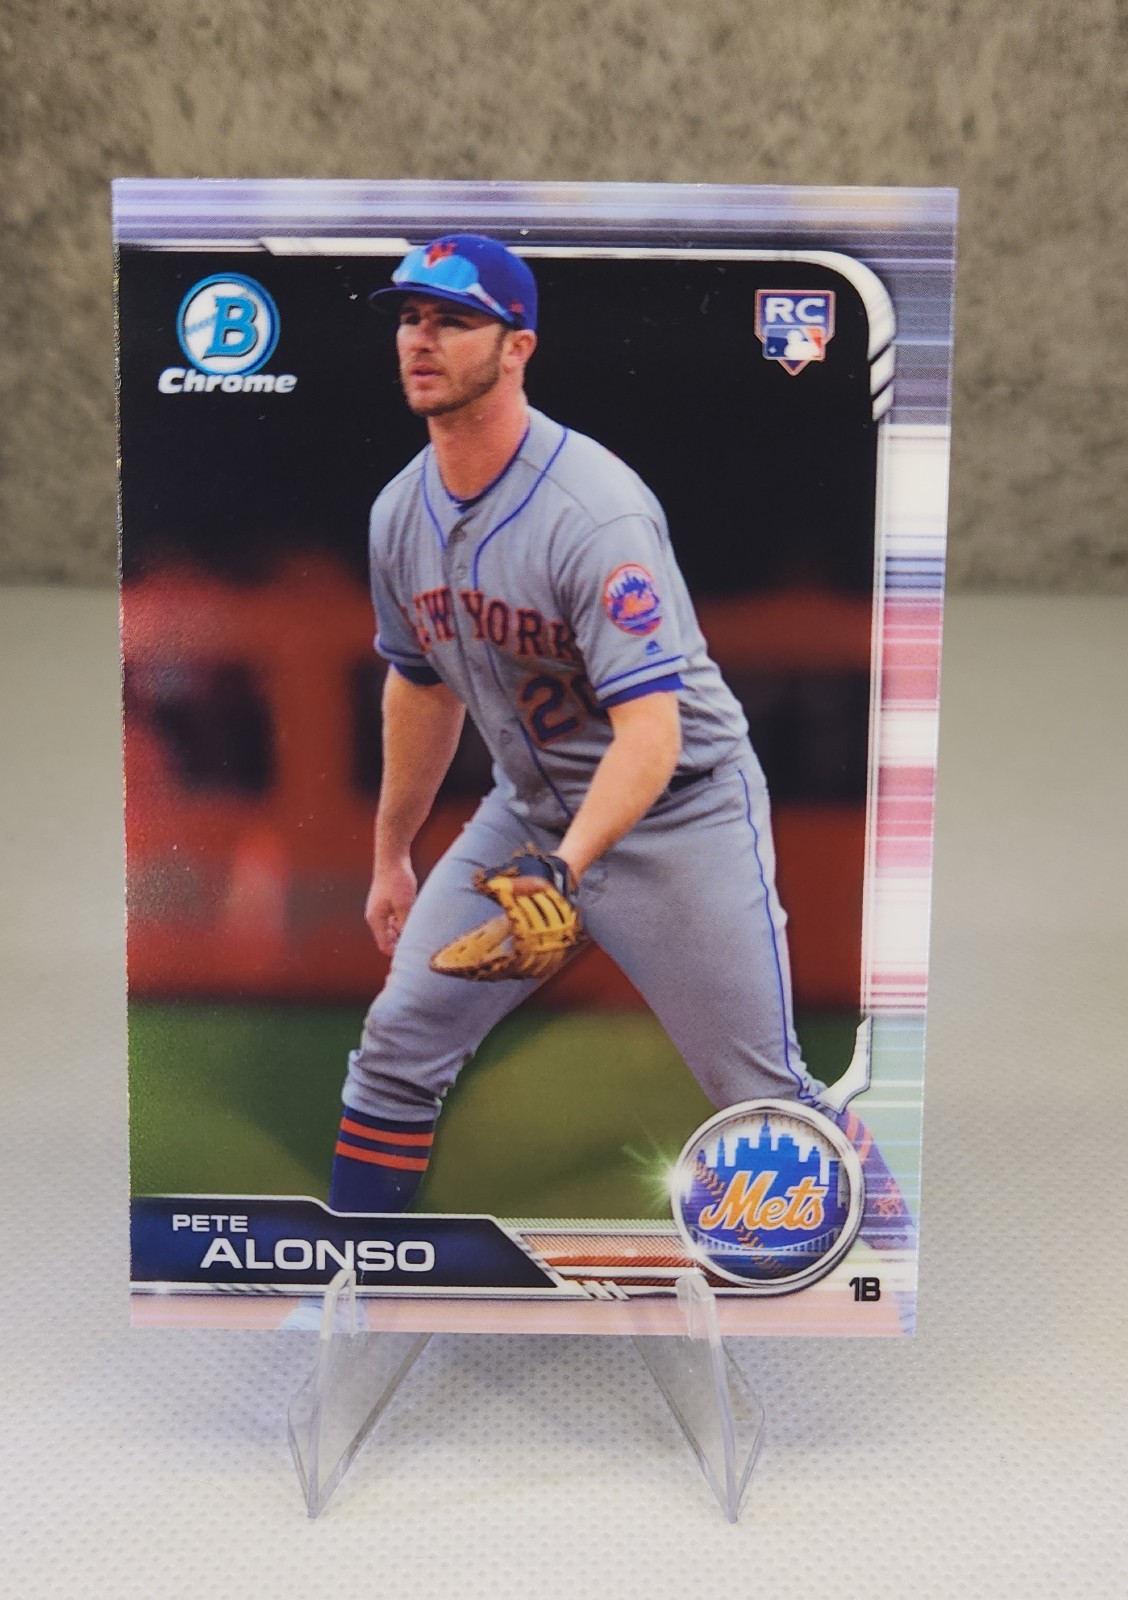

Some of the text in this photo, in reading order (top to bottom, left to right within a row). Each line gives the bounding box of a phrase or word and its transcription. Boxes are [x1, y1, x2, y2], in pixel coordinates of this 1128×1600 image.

[764, 297, 826, 323] RC
[202, 295, 259, 361] B
[157, 366, 298, 394] Chrome
[699, 1170, 830, 1231] Mets
[172, 1213, 249, 1233] PETE
[200, 1237, 436, 1273] ALONSO
[848, 1276, 881, 1302] 1B
